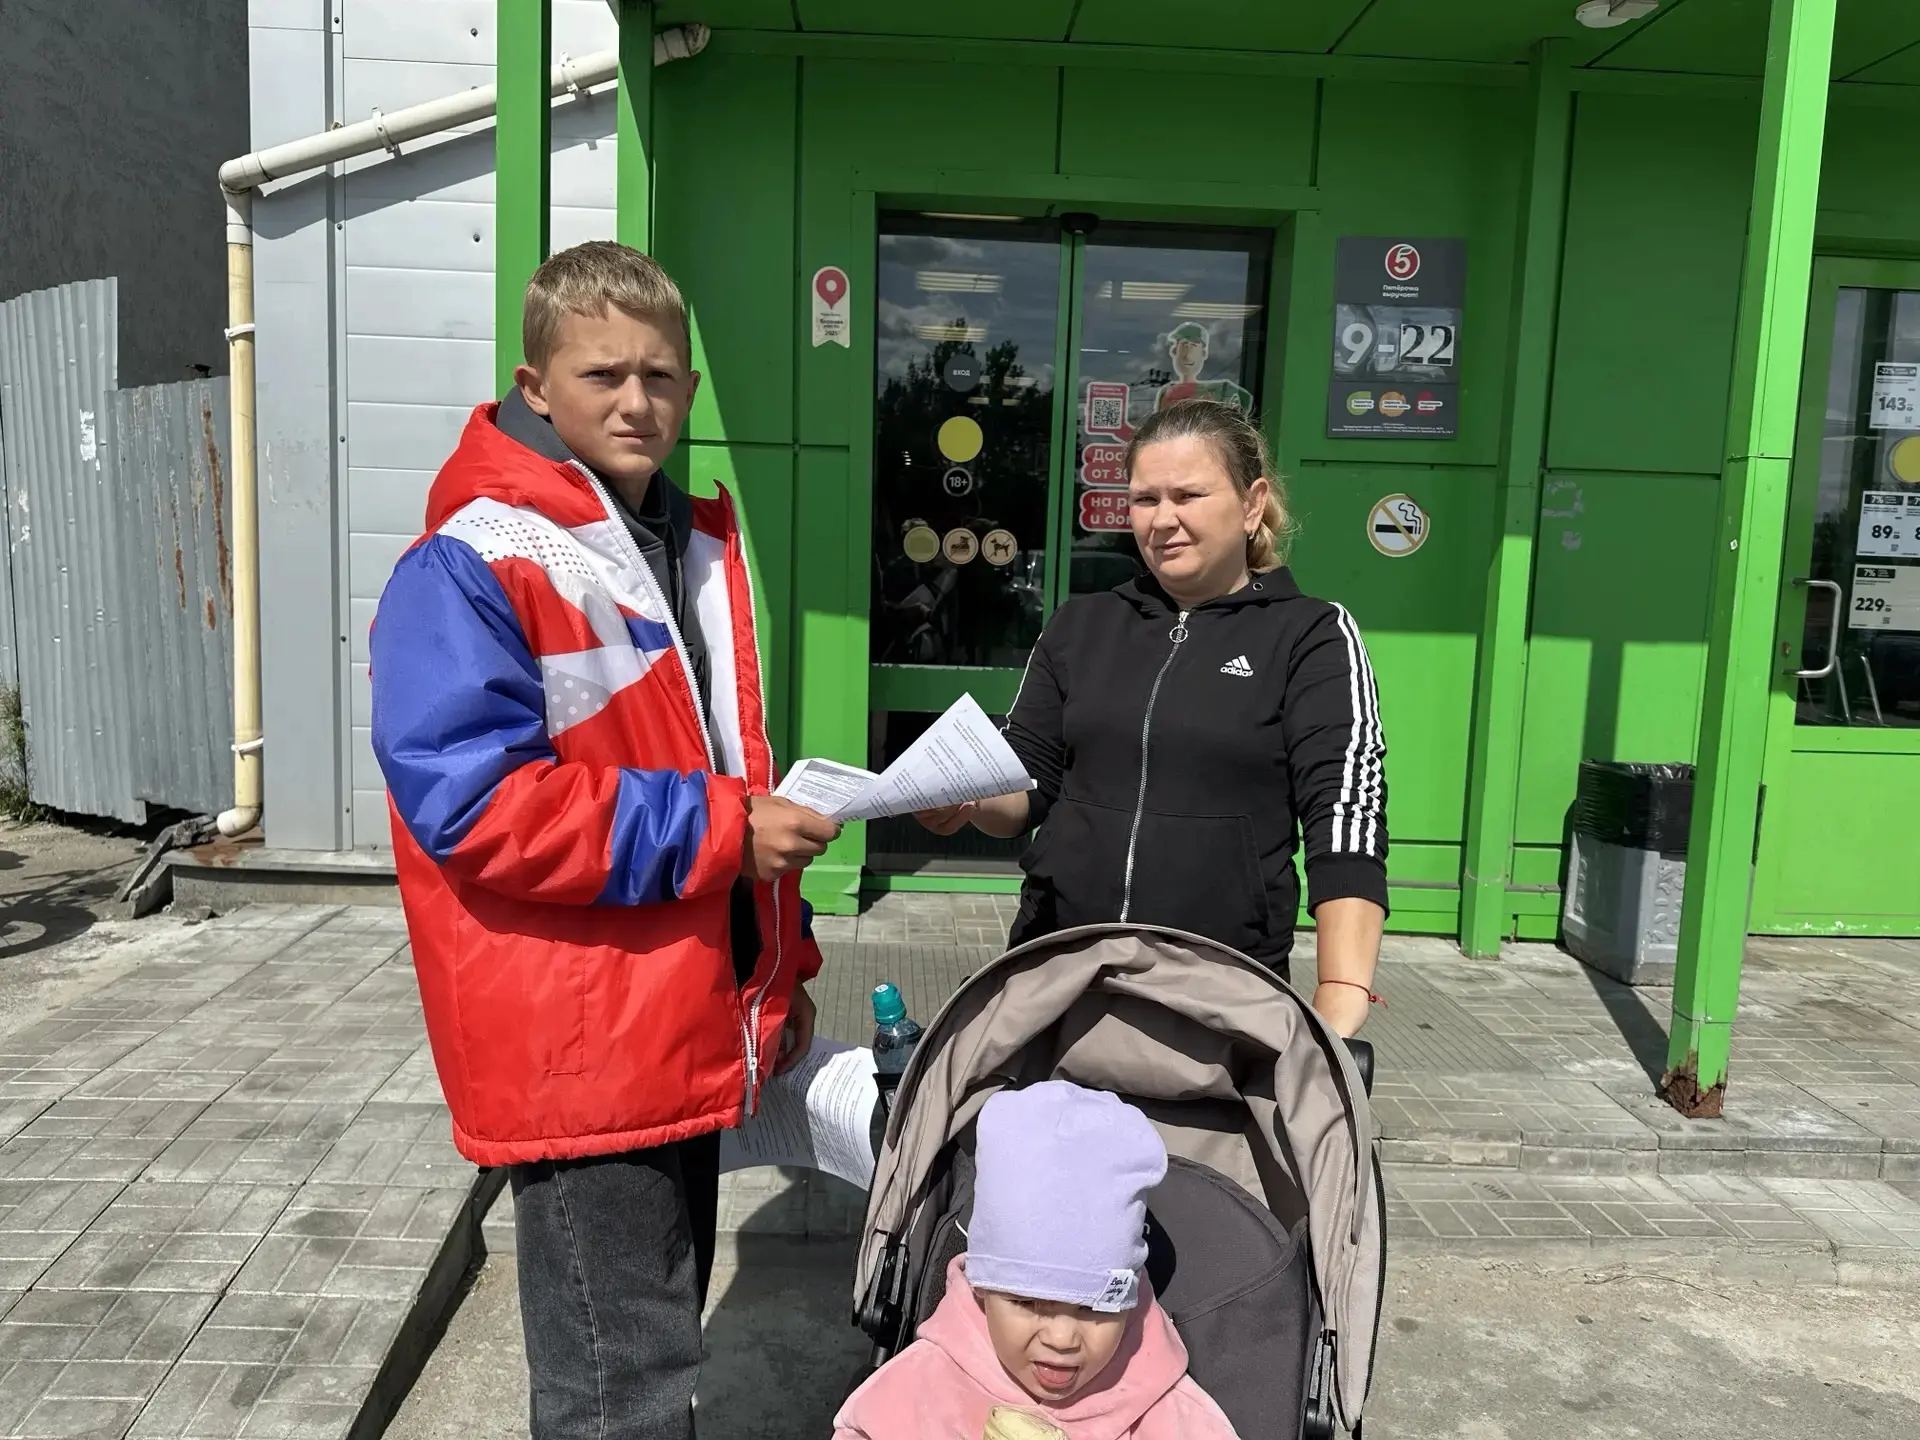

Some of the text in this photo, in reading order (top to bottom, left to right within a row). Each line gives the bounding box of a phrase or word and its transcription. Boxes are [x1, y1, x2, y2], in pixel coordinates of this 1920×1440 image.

[1092, 448, 1123, 463] Дос
[1091, 468, 1111, 479] от
[949, 477, 968, 488] 18+
[1091, 496, 1112, 508] на
[1089, 514, 1101, 525] и
[1872, 525, 1893, 539] 89
[1855, 597, 1886, 612] 229
[1220, 666, 1254, 677] adidas
